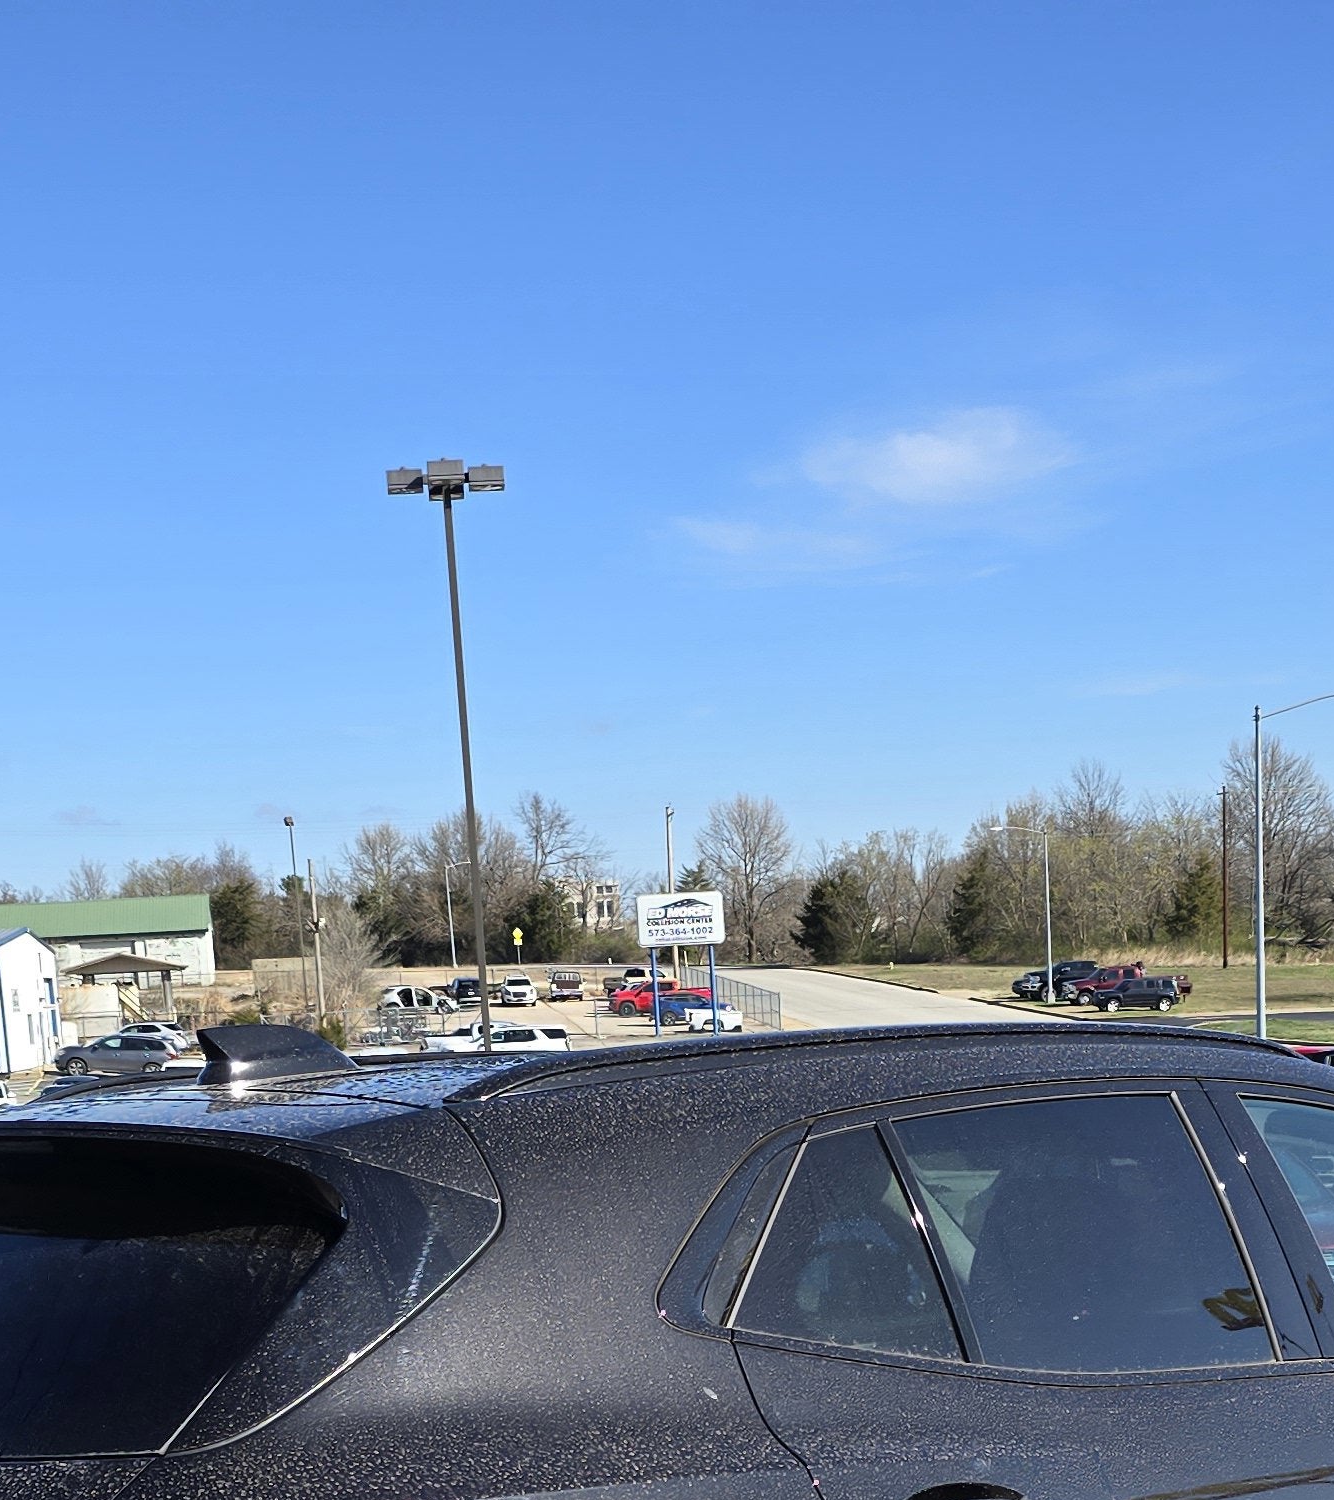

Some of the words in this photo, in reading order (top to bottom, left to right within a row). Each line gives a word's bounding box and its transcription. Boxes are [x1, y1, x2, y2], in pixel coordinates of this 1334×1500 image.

[647, 908, 666, 920] ED
[667, 905, 713, 919] MORSE
[647, 919, 685, 927] COLLISION
[648, 927, 713, 936] 573-364-1002
